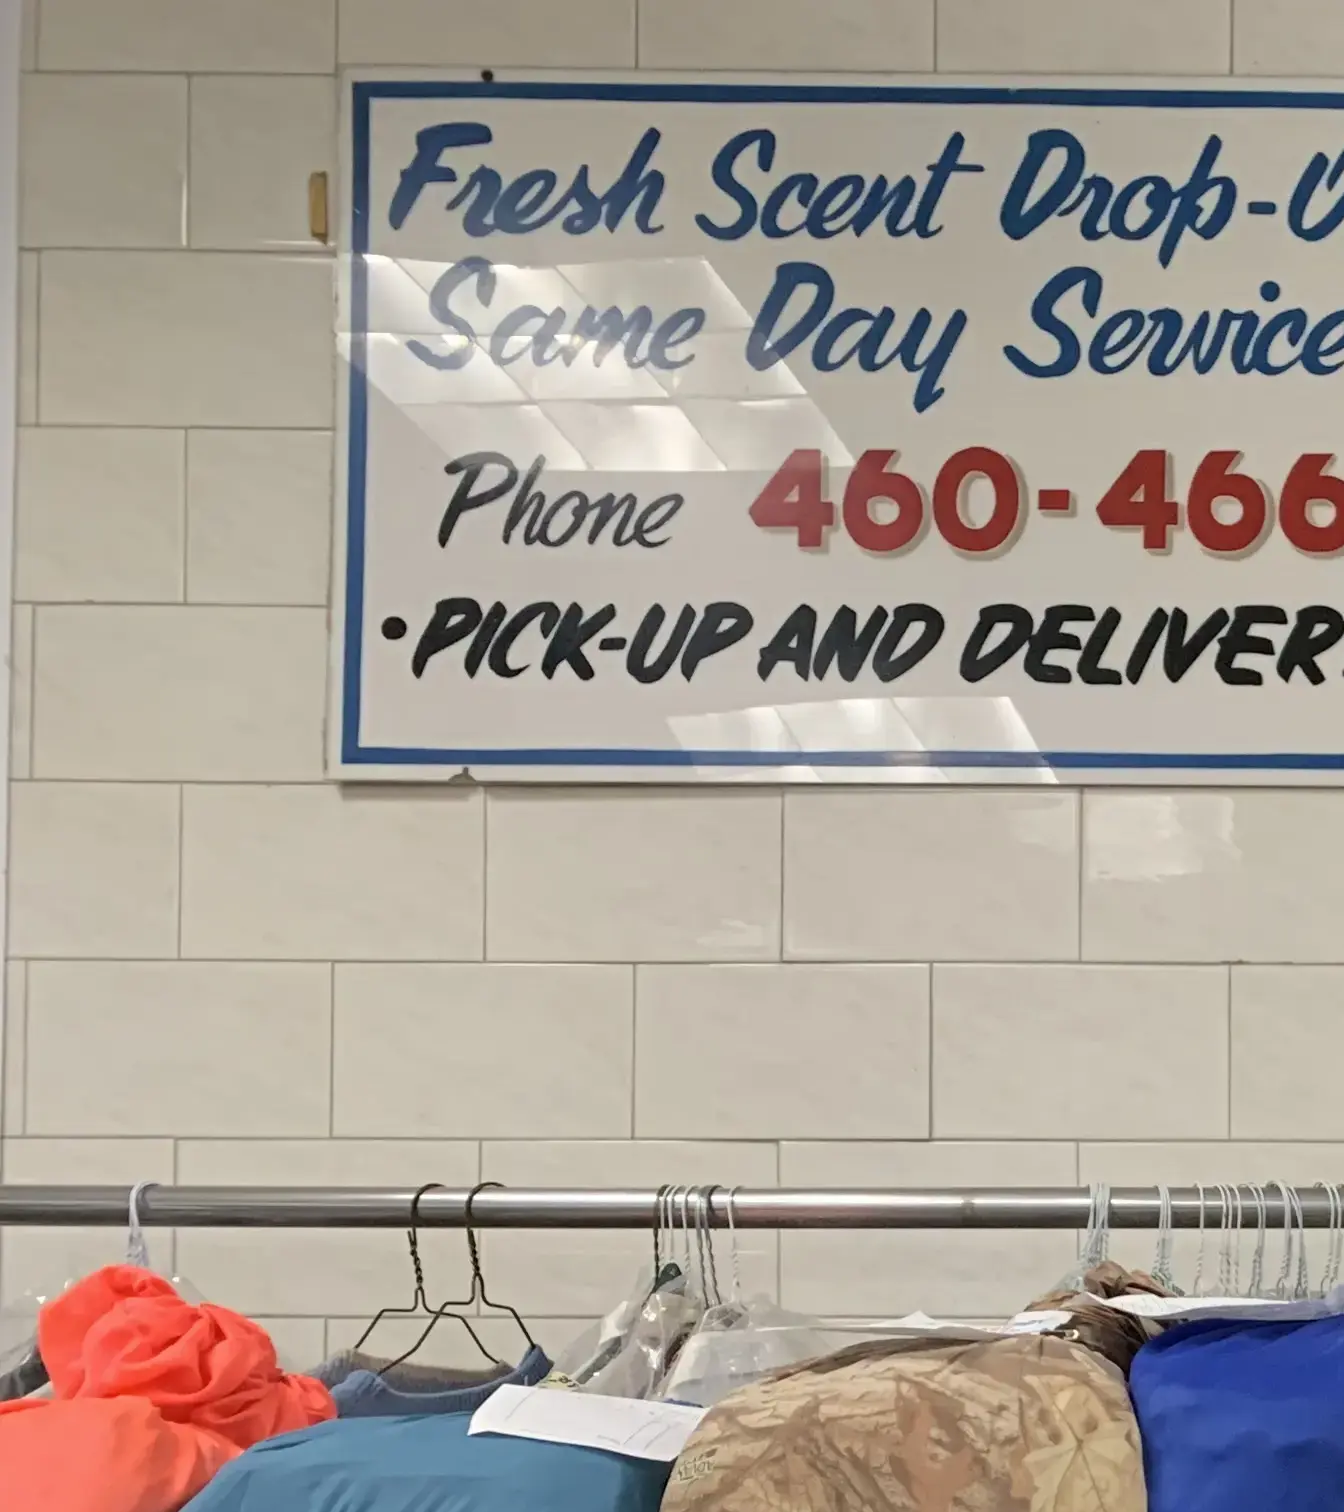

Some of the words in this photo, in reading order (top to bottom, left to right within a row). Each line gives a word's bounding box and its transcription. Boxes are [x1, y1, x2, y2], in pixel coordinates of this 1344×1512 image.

[389, 122, 665, 237] Fresh
[695, 127, 984, 241] Scent
[407, 257, 705, 372] Same
[745, 262, 967, 413] Day
[437, 451, 684, 549] Phone
[412, 598, 753, 683] PICK-UP
[758, 603, 945, 683] AND
